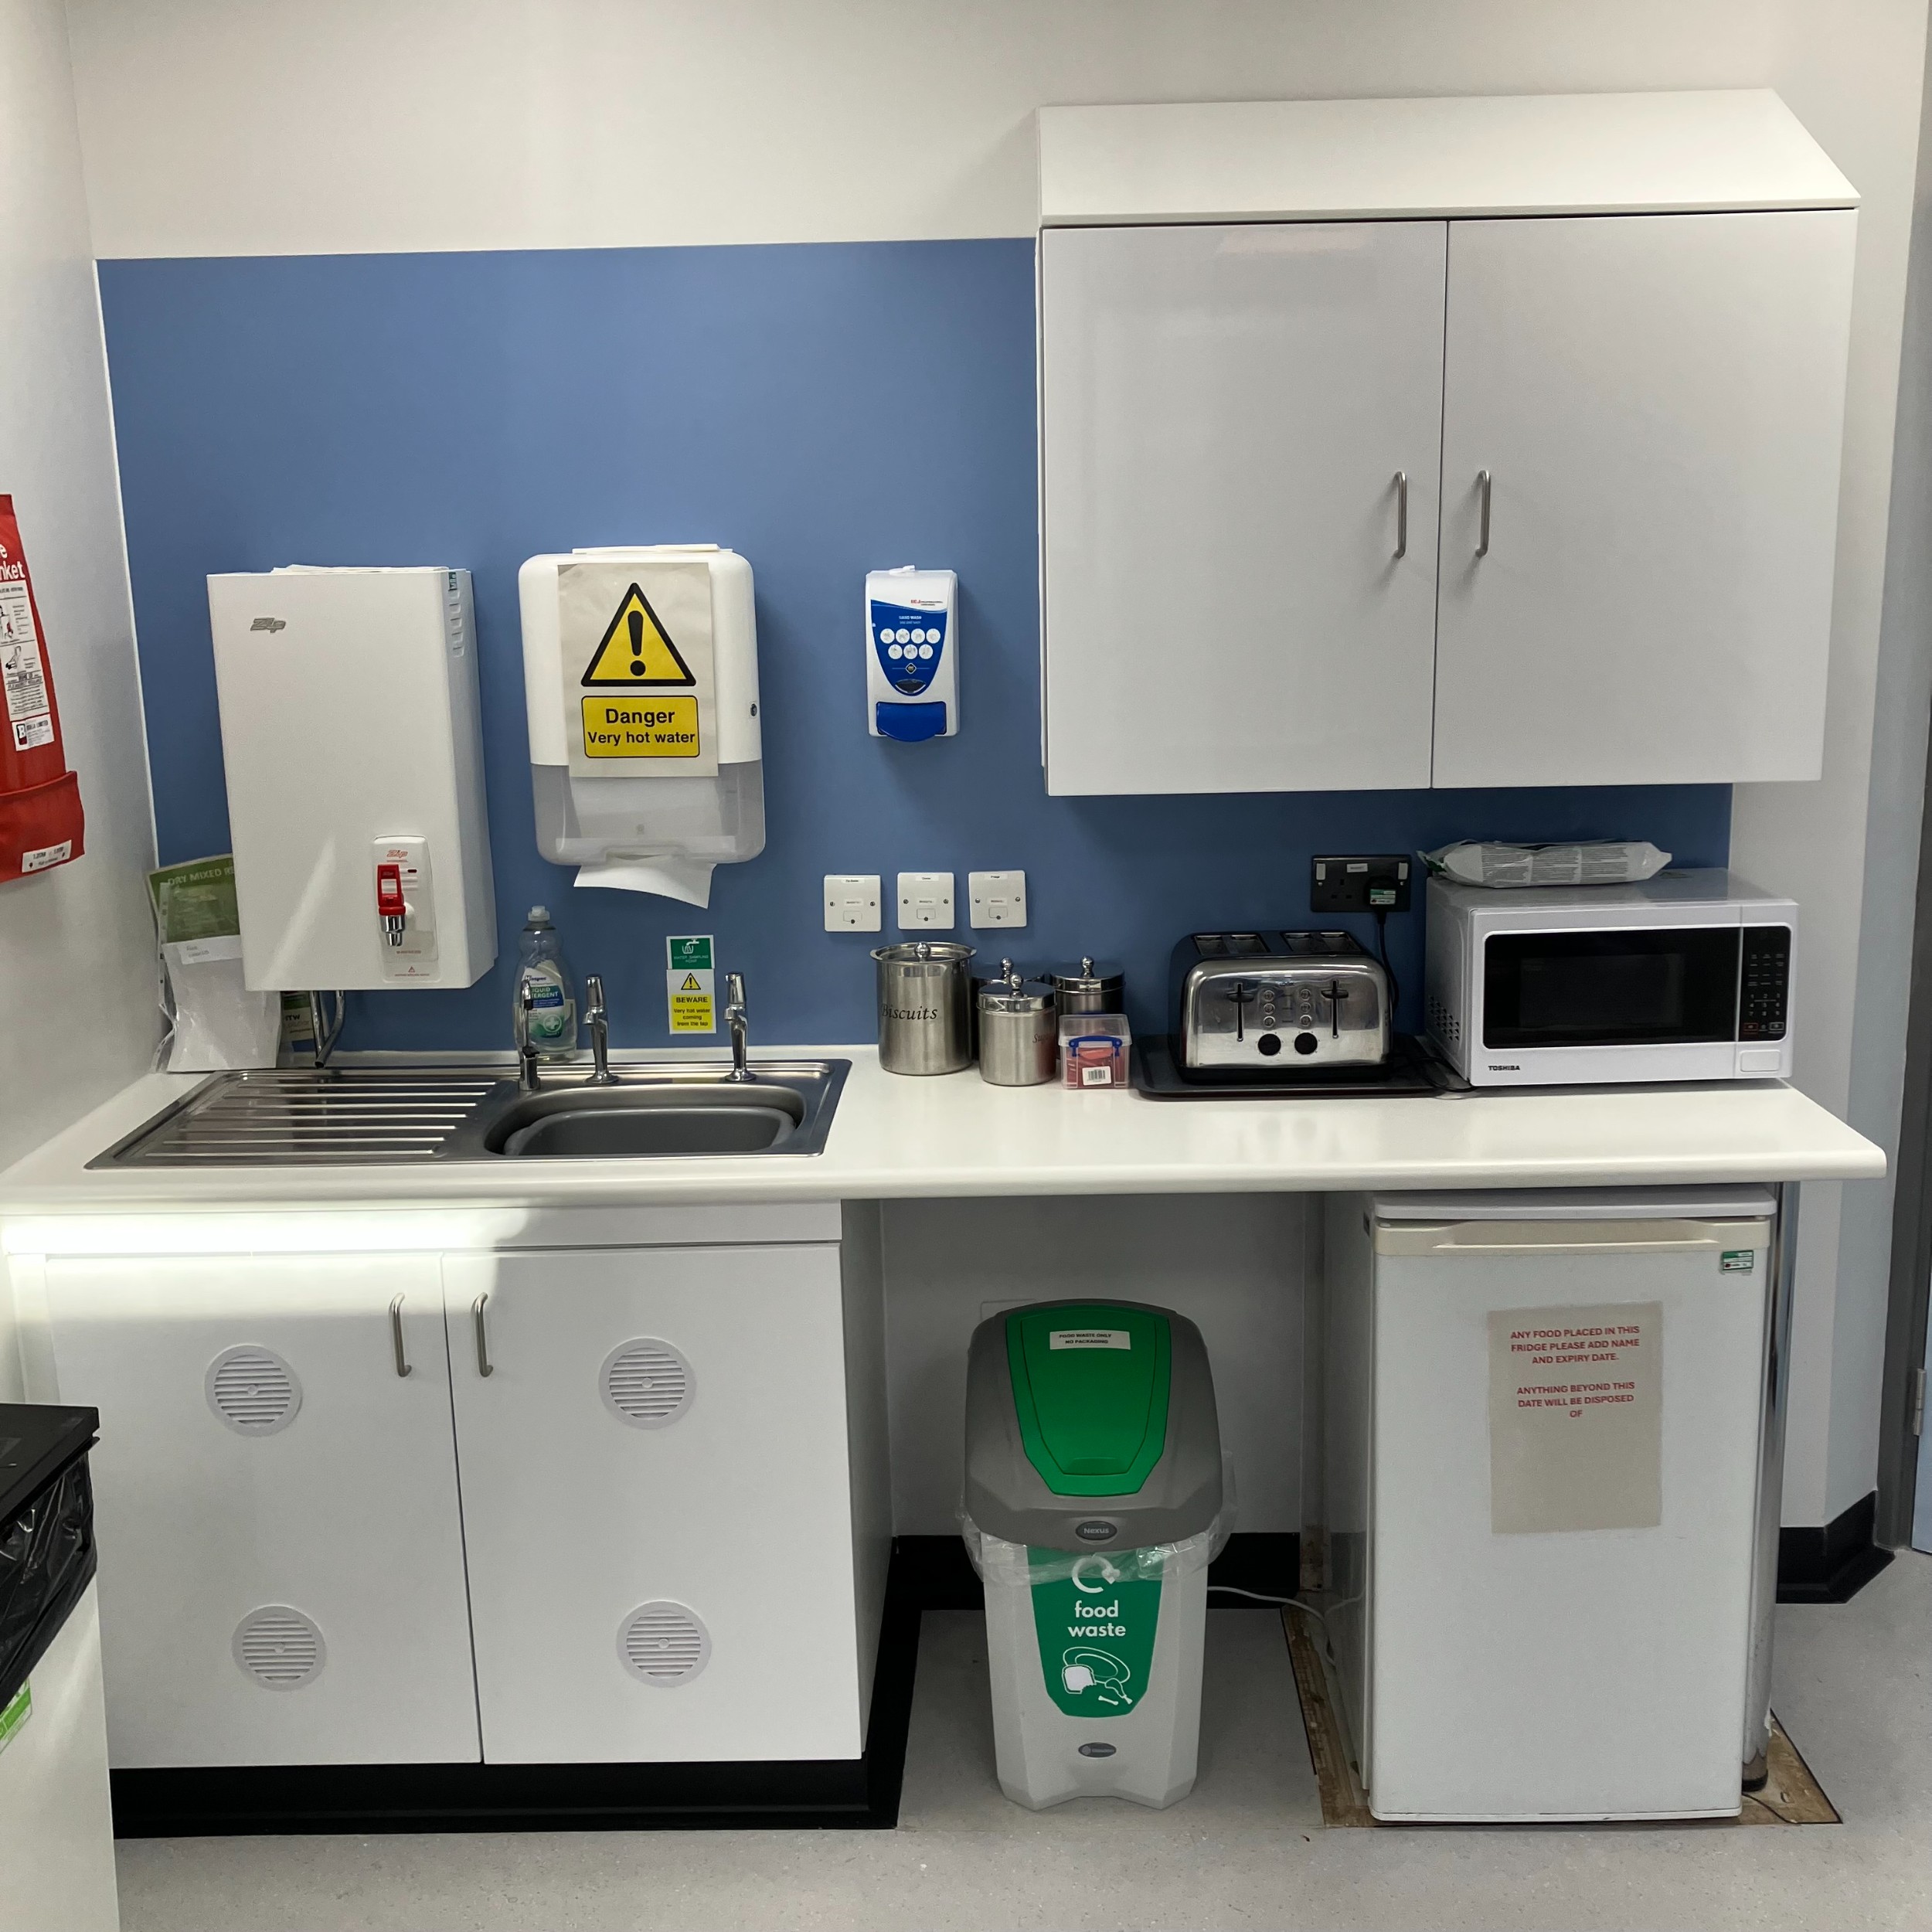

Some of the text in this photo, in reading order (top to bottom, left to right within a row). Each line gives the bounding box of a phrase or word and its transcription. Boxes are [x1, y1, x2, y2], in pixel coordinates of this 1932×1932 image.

[605, 708, 675, 727] Danger
[588, 731, 695, 746] Very hot water
[168, 876, 186, 885] DRY
[190, 869, 221, 881] MIXED
[881, 1004, 938, 1021] Biscuits
[1533, 1330, 1561, 1338] FOOD
[1564, 1328, 1602, 1337] PLACED
[1617, 1326, 1640, 1334] THIS
[1511, 1339, 1640, 1352] FRIDGE PLEASE ADD NAME
[1532, 1353, 1619, 1364] AND EXPIRY DATE.
[1517, 1382, 1635, 1395] ANYTHING BEYOND THIS
[1518, 1399, 1542, 1407] DATE
[1544, 1398, 1568, 1406] WILL
[1584, 1395, 1634, 1404] DISPOSED
[1075, 1600, 1119, 1618] food
[1068, 1624, 1126, 1637] waste
